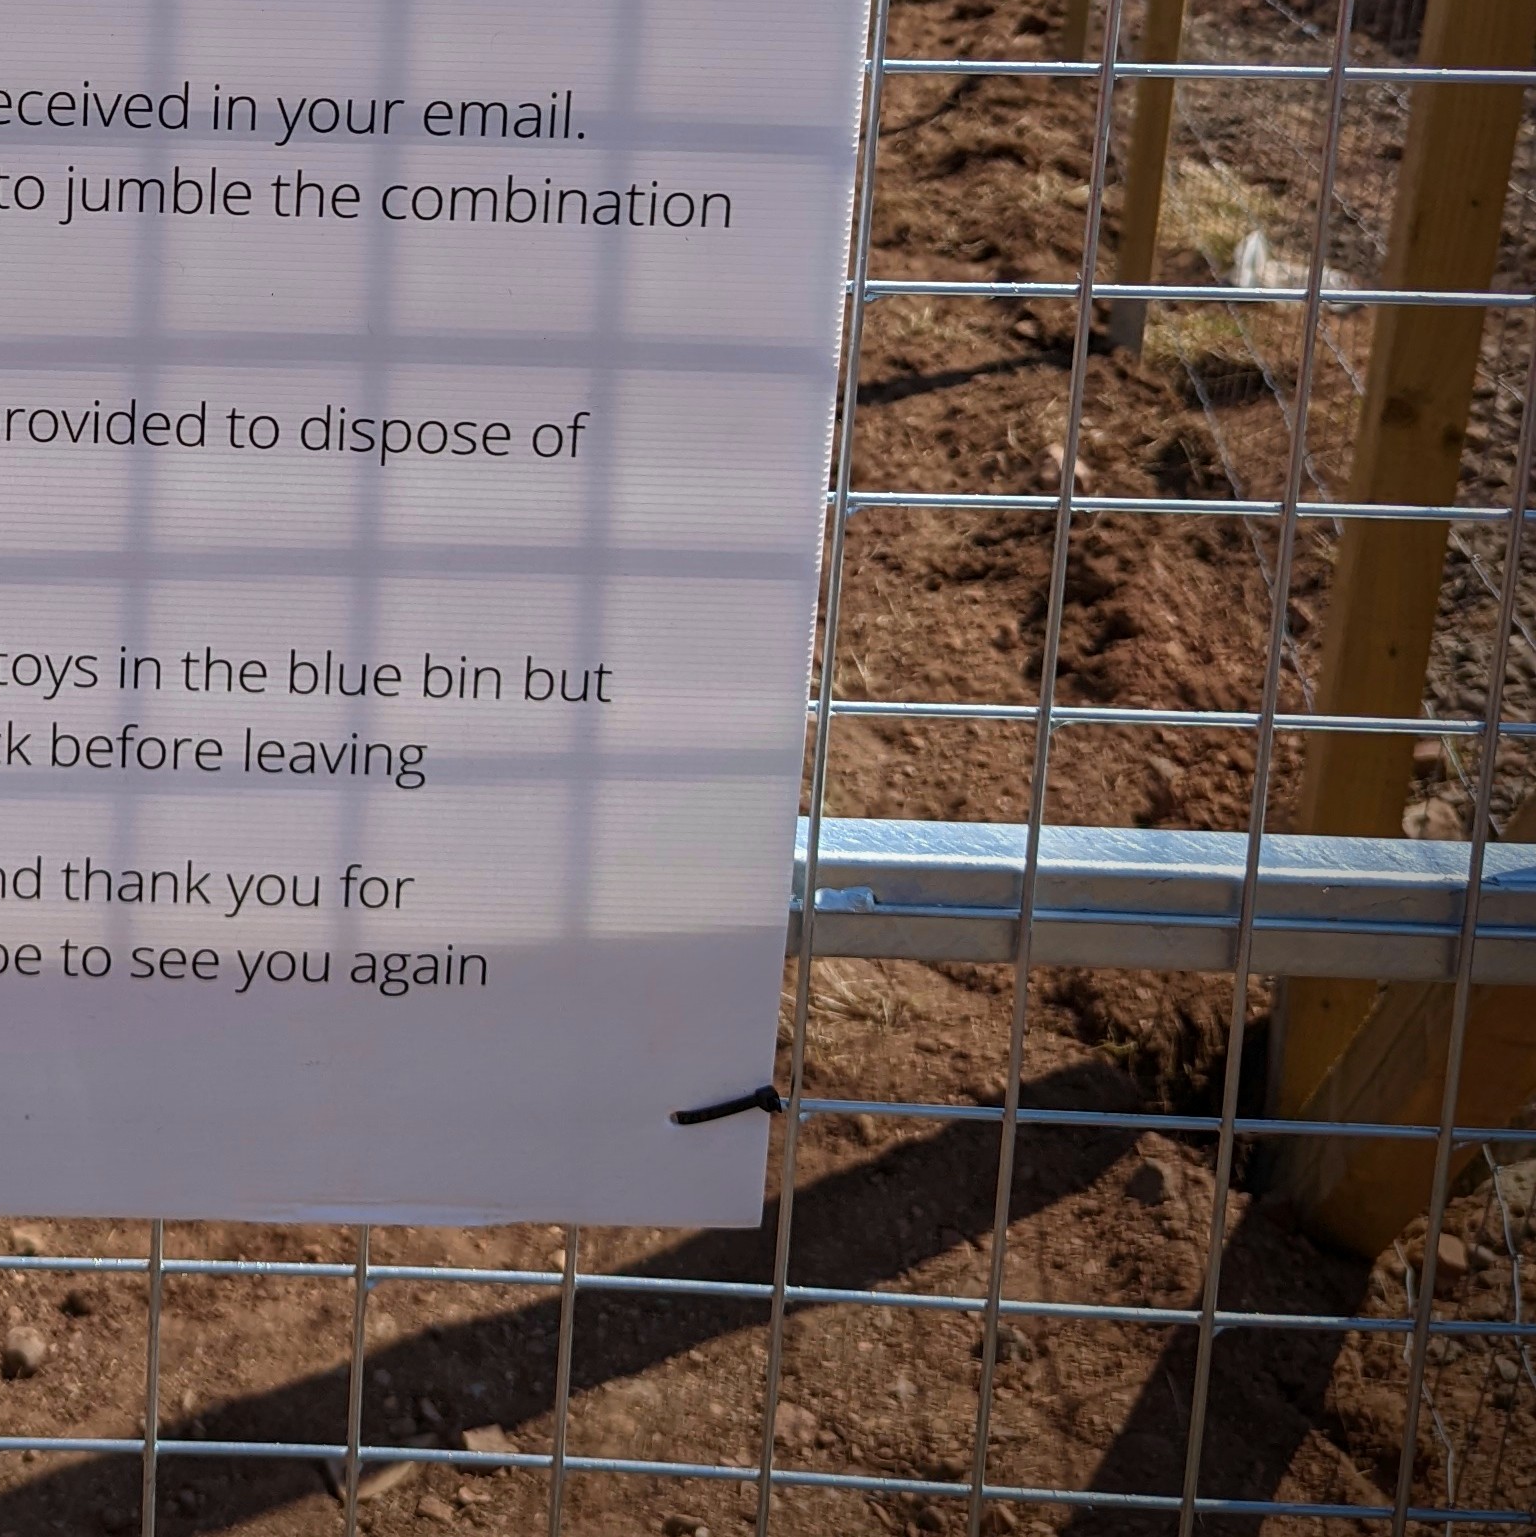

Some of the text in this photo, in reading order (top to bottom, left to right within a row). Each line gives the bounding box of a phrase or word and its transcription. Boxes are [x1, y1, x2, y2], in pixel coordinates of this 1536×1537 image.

[211, 82, 258, 133] in
[273, 96, 407, 148] your
[422, 88, 586, 141] email.
[57, 164, 253, 227] jumble
[269, 167, 362, 220] the
[380, 173, 732, 230] combination
[224, 406, 281, 451] to
[299, 403, 512, 468] dispose
[531, 410, 592, 460] of
[118, 644, 162, 691] in
[179, 645, 269, 695] the
[287, 647, 403, 699] blue
[421, 651, 503, 701] bin
[523, 654, 614, 704] but
[50, 720, 224, 774] before
[243, 725, 429, 791] leaving
[59, 855, 213, 906] thank
[223, 872, 321, 919] you
[338, 862, 417, 911] for
[59, 937, 113, 979] to
[129, 946, 221, 982] see
[233, 948, 331, 995] you
[349, 942, 488, 998] again
